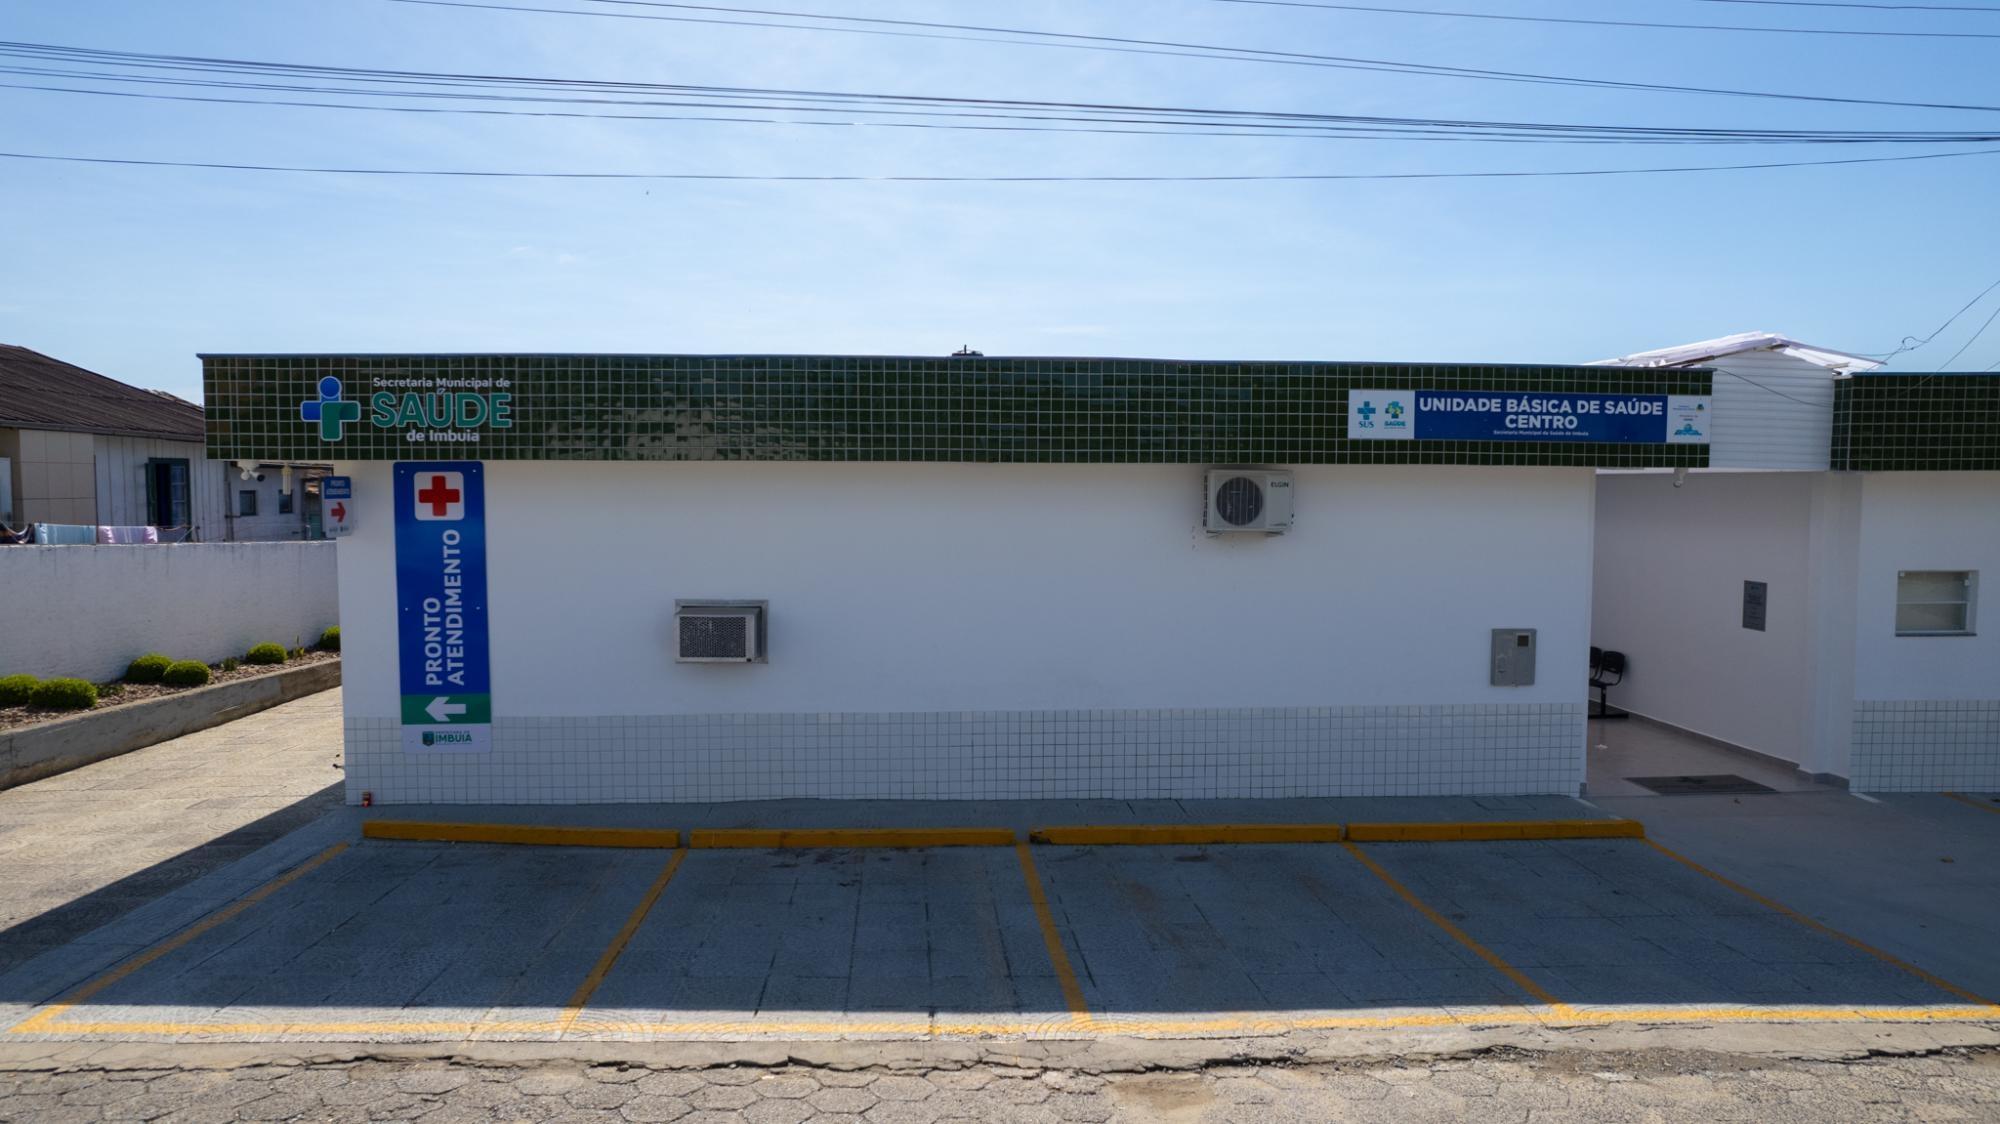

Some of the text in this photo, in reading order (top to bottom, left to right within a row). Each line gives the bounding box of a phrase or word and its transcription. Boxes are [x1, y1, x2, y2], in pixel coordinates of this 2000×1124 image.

[373, 377, 511, 389] Secretaria Municipal de
[371, 388, 512, 428] SAÚDE
[1419, 395, 1663, 415] UNIDADE BÁSICA DE SAÚDE
[1358, 421, 1375, 429] SUS
[1505, 414, 1578, 429] CENTRO
[406, 429, 480, 442] de Imbuia
[442, 529, 465, 687] ATENDIMENTO
[423, 597, 443, 686] PRONTO
[435, 734, 473, 743] IMBUIA
